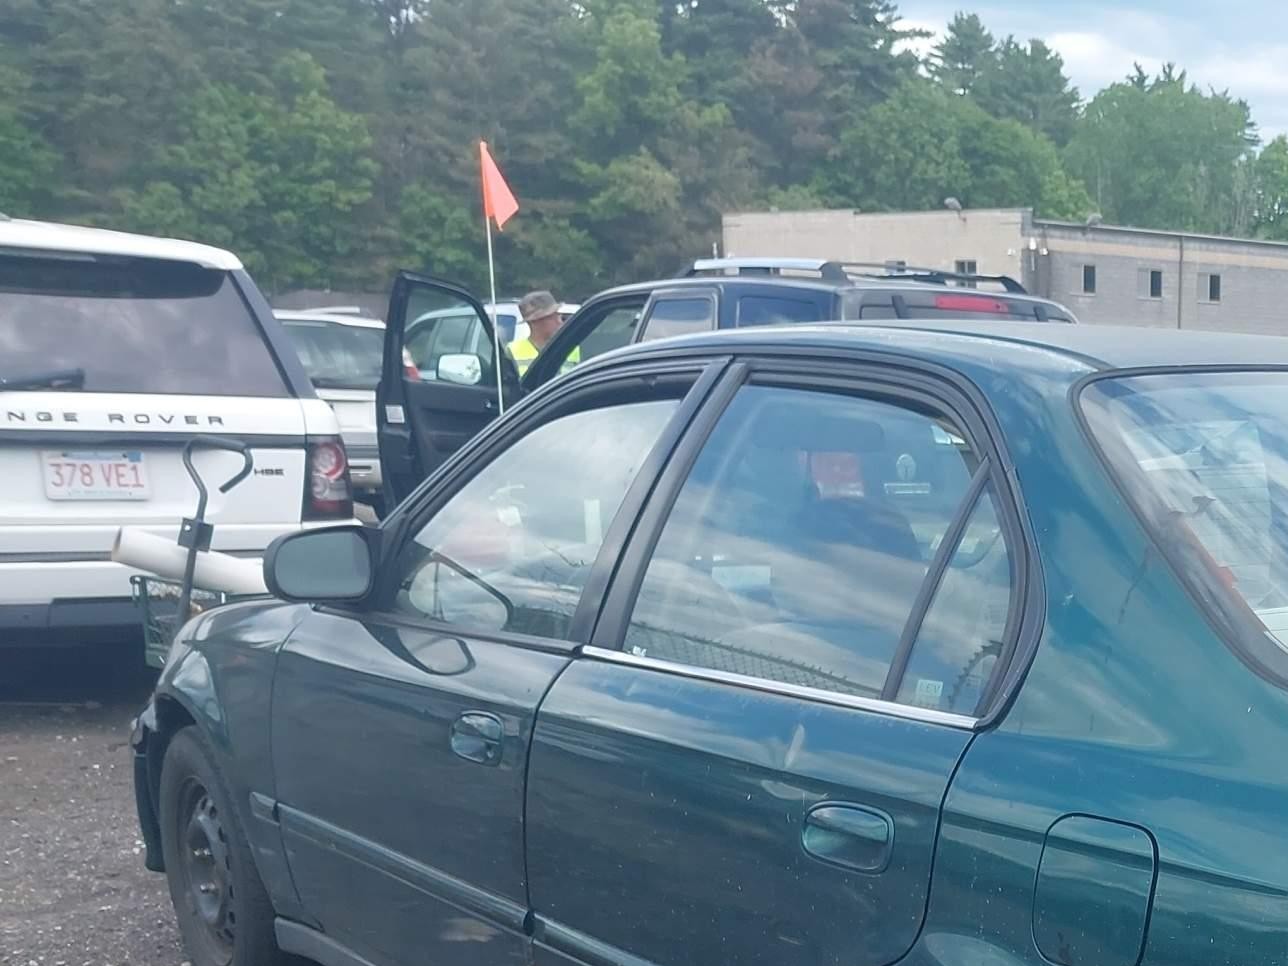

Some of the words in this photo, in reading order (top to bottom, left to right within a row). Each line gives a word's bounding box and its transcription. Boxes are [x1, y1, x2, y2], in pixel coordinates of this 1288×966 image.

[107, 411, 225, 427] ROVER
[48, 462, 95, 488] 378
[100, 462, 145, 489] VE1
